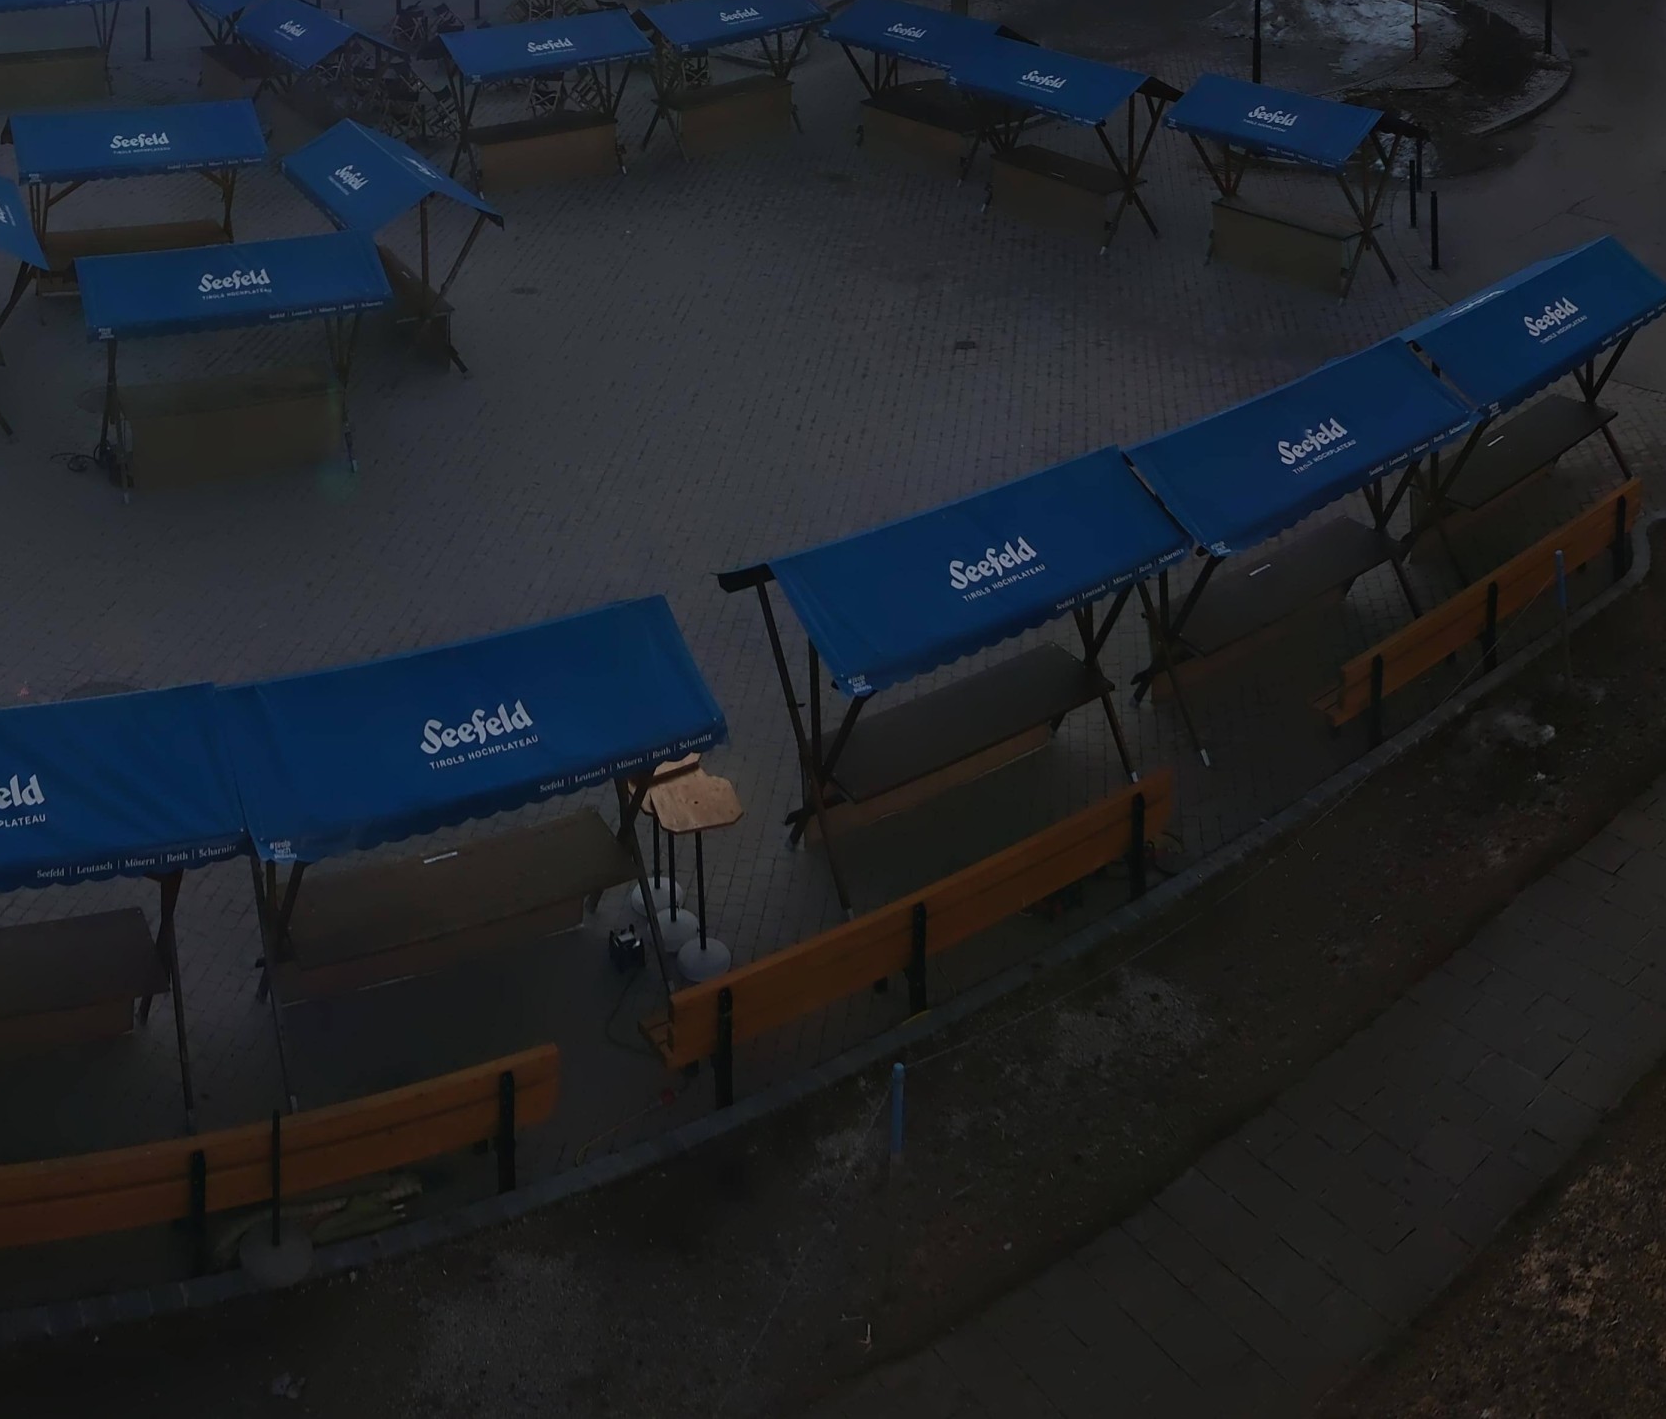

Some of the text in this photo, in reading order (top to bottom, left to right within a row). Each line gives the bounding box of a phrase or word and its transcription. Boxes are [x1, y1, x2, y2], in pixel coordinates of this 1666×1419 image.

[110, 132, 169, 149] Seefeld
[198, 268, 271, 292] Seefeld
[1278, 417, 1348, 465] Seefeld
[949, 536, 1038, 590] Seefeld
[420, 699, 534, 755] Seefeld
[429, 734, 539, 770] TIROLS HOCHPLATEAU
[539, 779, 564, 793] Seefeld
[575, 767, 606, 783] Leutasch
[615, 756, 643, 771] Mösern
[652, 748, 671, 760] Reith
[36, 867, 65, 878] Seefeld
[76, 862, 113, 874] Leutasch
[124, 856, 156, 869] Mösern
[166, 851, 188, 863] Reith
